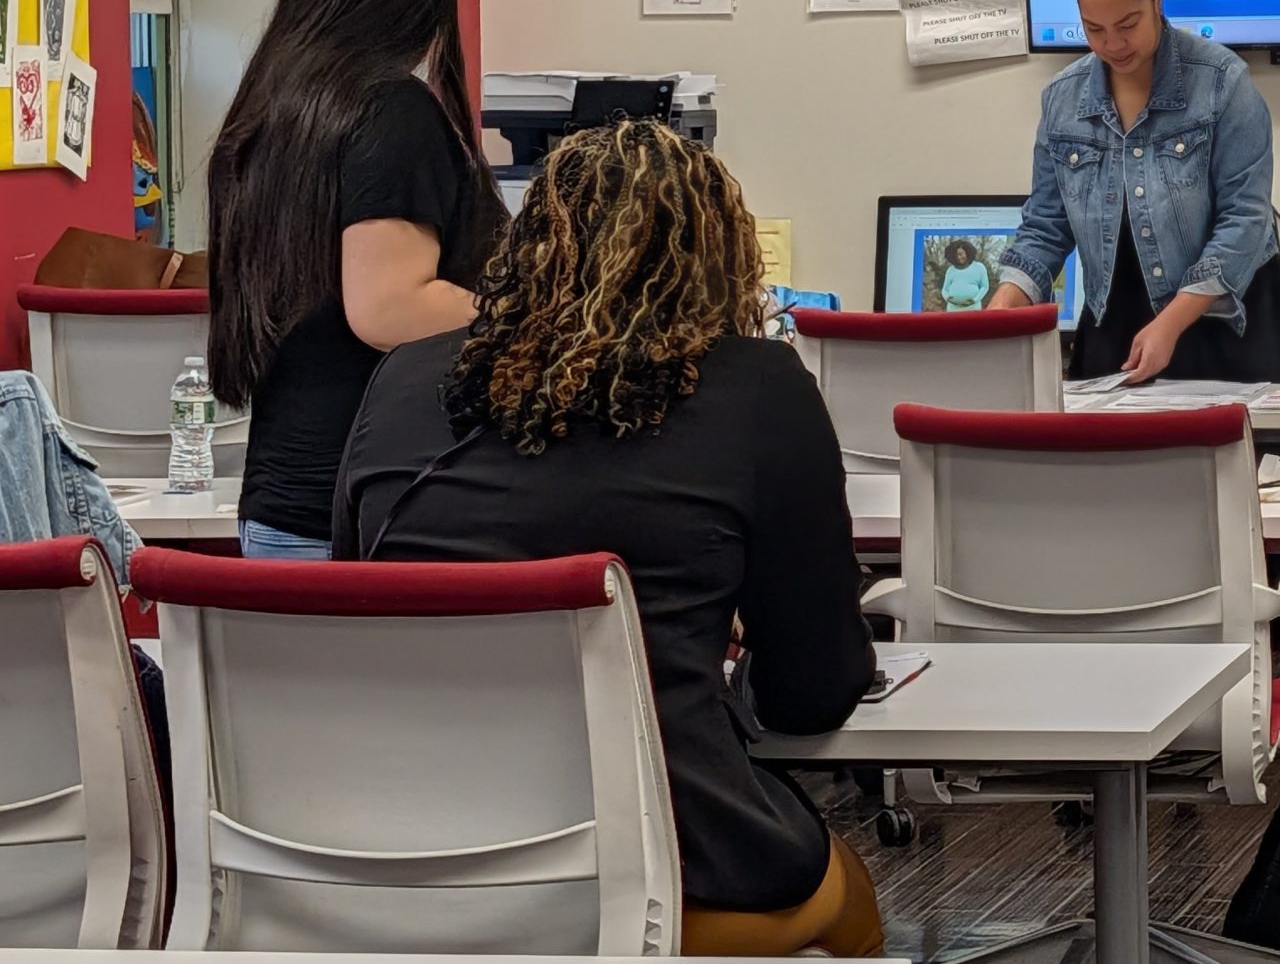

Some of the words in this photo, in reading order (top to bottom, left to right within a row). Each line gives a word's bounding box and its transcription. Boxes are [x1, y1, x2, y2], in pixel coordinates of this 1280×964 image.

[909, 0, 934, 10] PLEASE
[922, 17, 947, 26] PLEASE
[983, 10, 996, 18] THE
[934, 36, 959, 44] PLEASE
[960, 34, 980, 42] SHUT
[1010, 28, 1020, 36] TV
